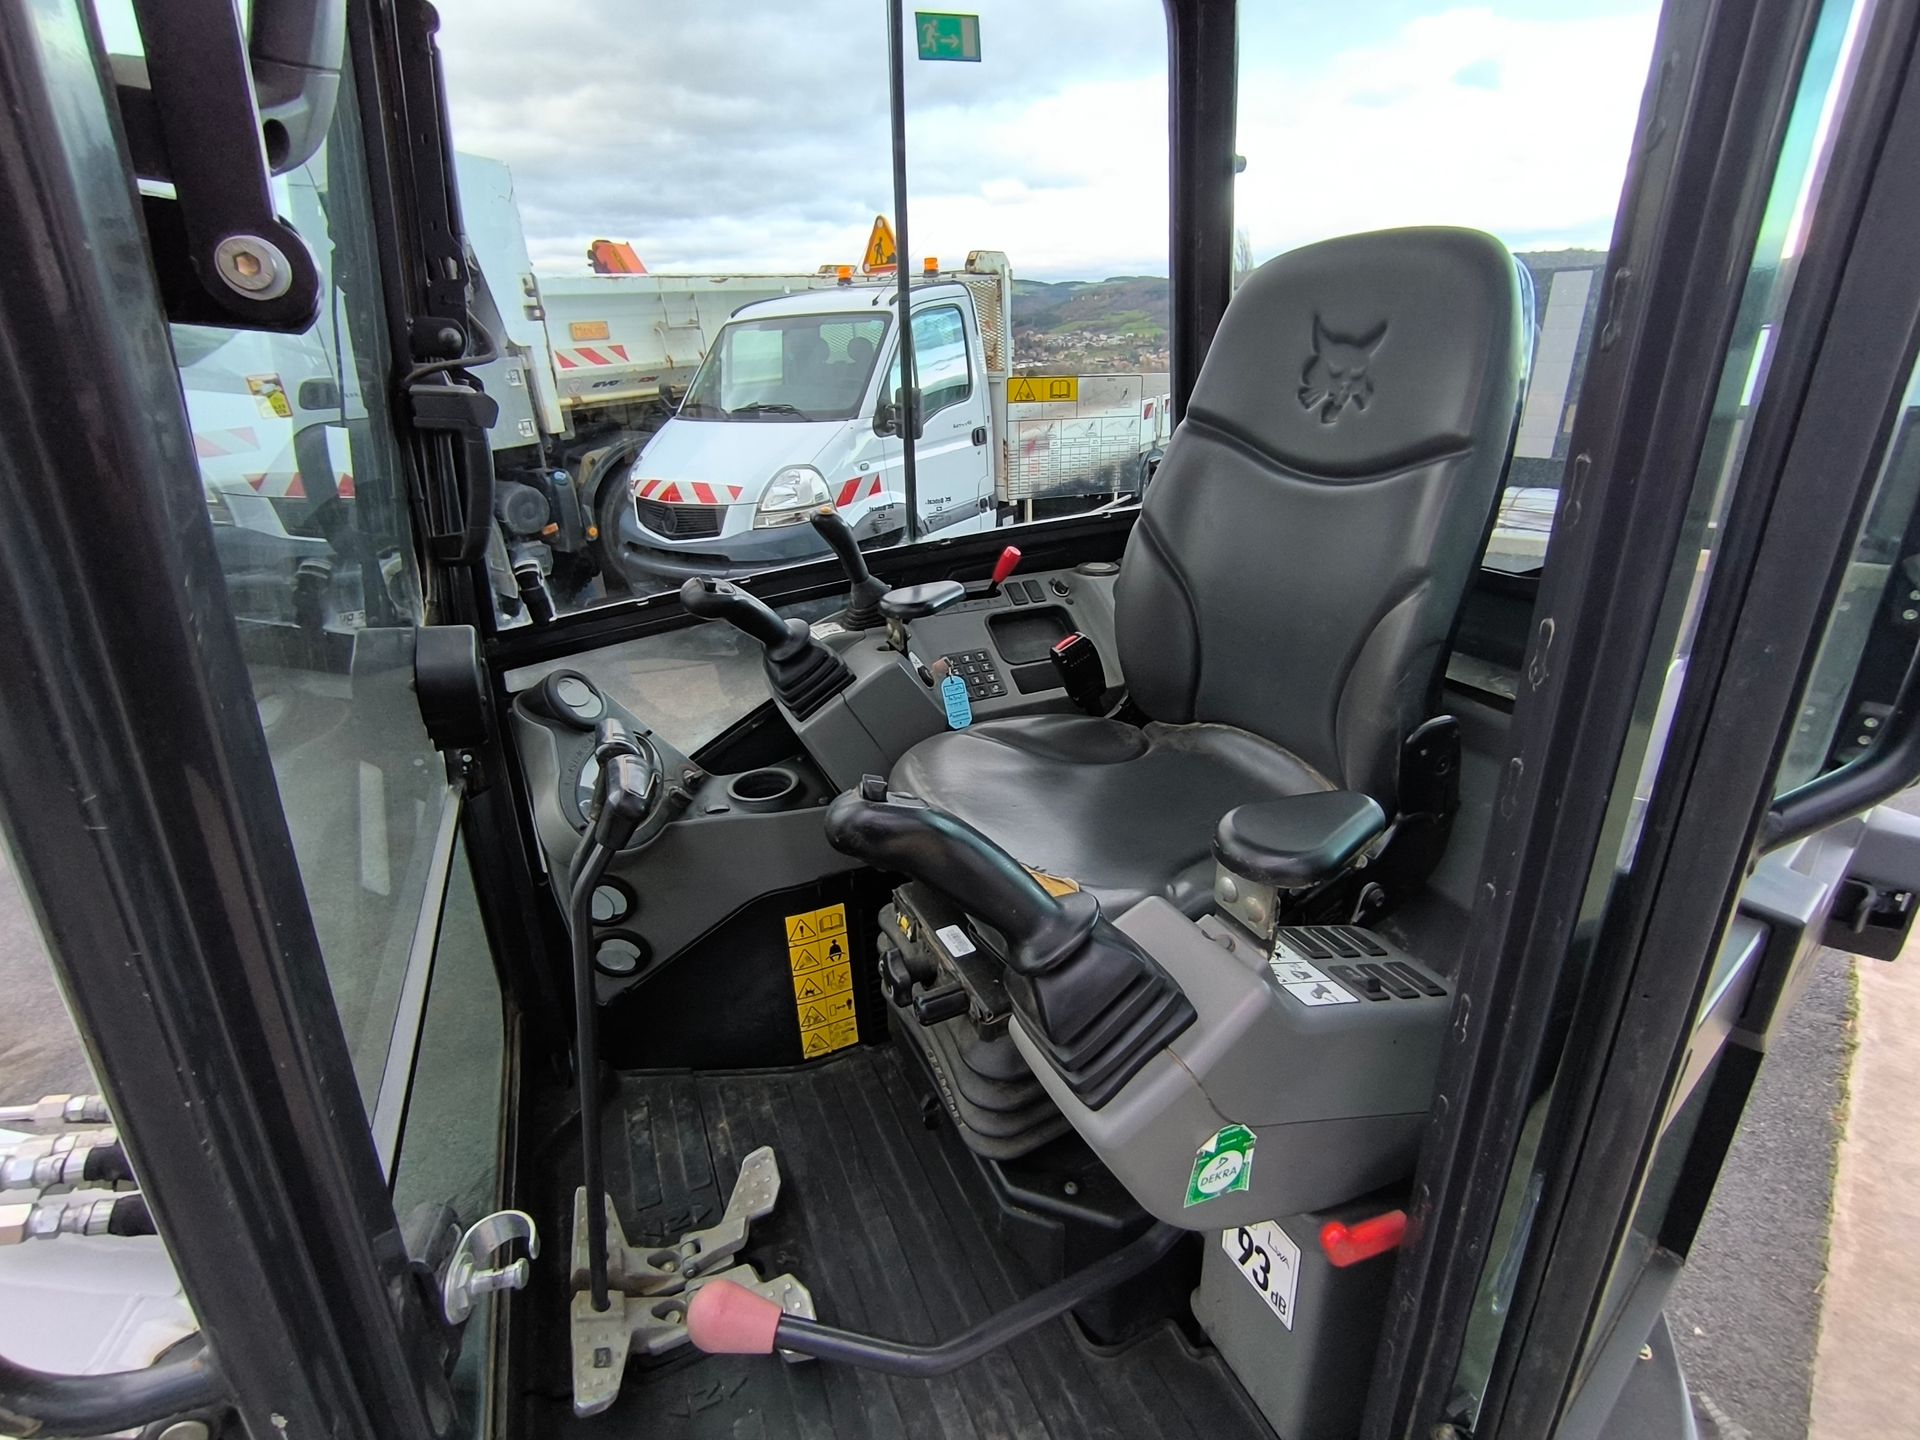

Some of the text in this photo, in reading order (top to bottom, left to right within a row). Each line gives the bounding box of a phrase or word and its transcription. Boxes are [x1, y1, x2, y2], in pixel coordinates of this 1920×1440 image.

[1200, 1166, 1237, 1188] DEKRA
[1238, 1227, 1271, 1292] 93
[1270, 1290, 1287, 1316] dB
